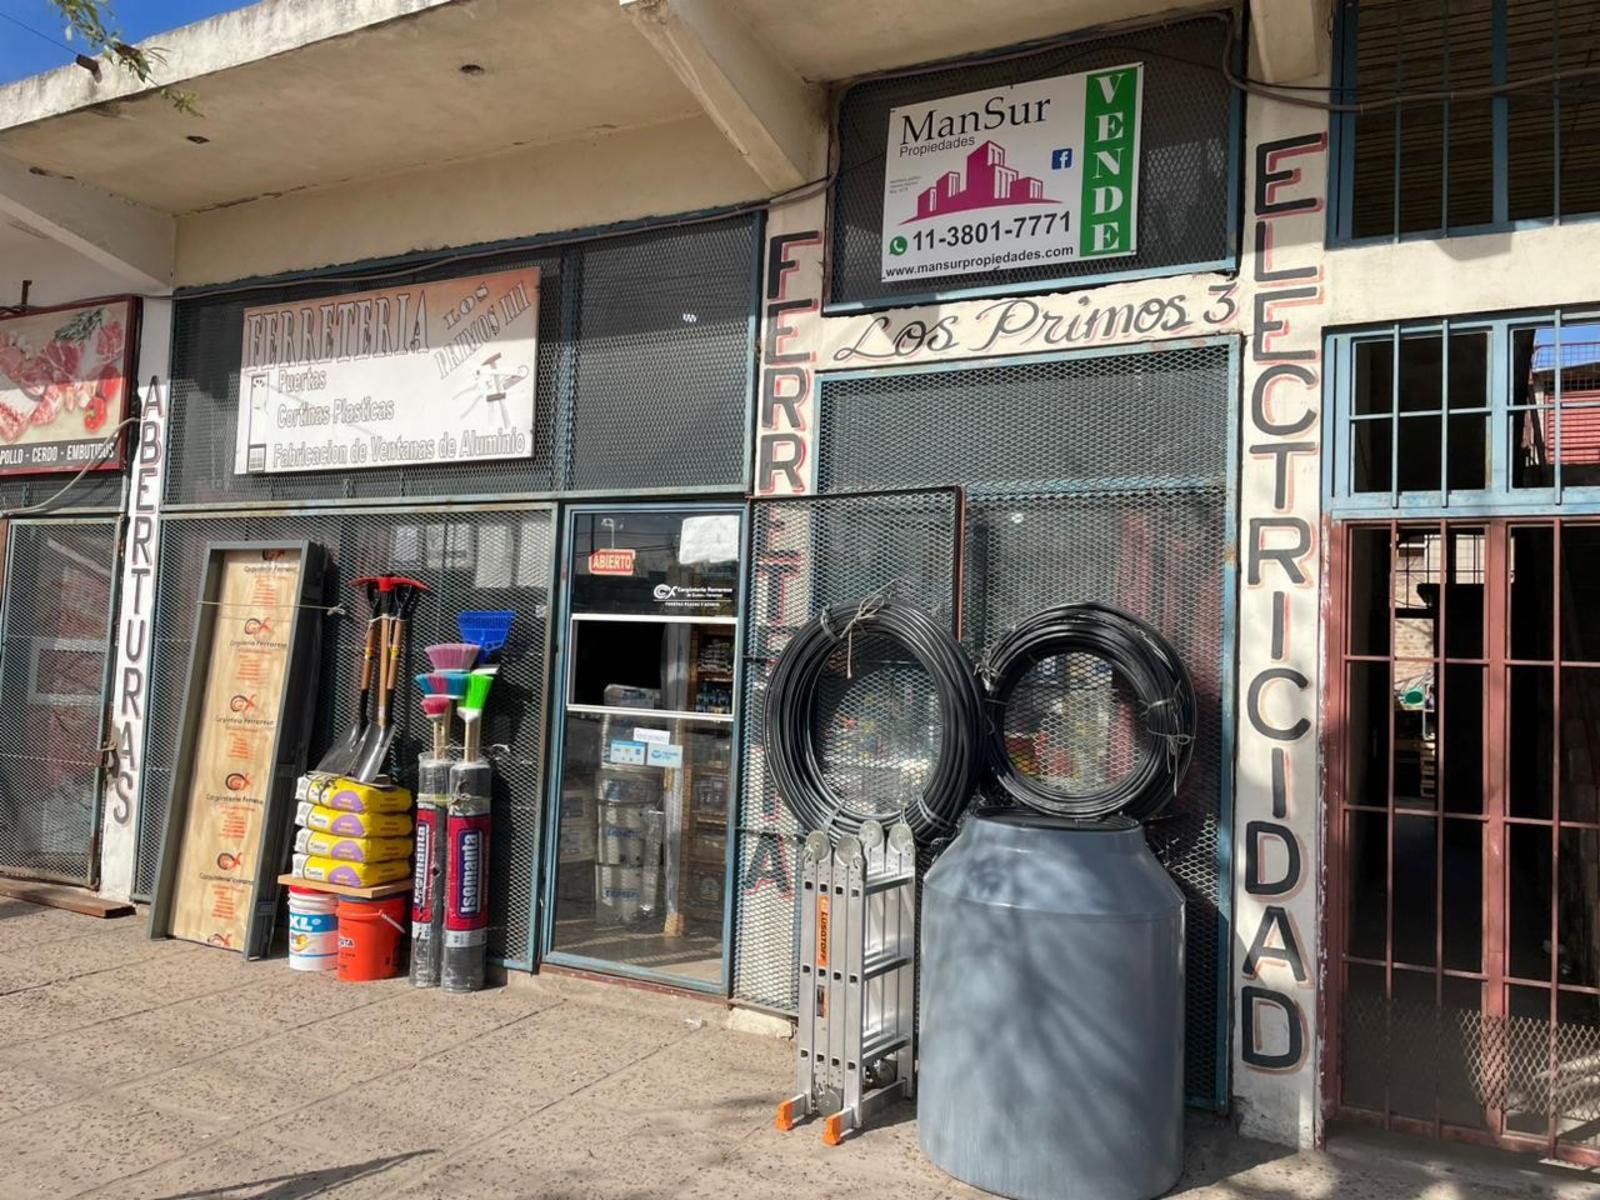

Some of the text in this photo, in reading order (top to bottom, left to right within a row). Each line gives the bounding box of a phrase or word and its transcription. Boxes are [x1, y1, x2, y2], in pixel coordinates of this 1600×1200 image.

[900, 96, 1051, 146] ManSur
[899, 136, 976, 158] Propiedades
[1090, 74, 1127, 252] VENDE
[912, 210, 1070, 251] 11-3801-7771
[886, 246, 1074, 278] www.mansurpropiedades.com
[247, 289, 430, 372] FERRETERIA
[832, 281, 1239, 361] Los Primos 3
[278, 367, 328, 394] Puertas
[31, 446, 58, 463] CERDO
[350, 436, 367, 464] de
[439, 432, 456, 458] de
[593, 555, 632, 570] ABIERTO
[113, 375, 164, 825] ABERTURAS
[1241, 131, 1327, 1073] ELECTRICIDAD
[460, 833, 478, 913] Isomanta
